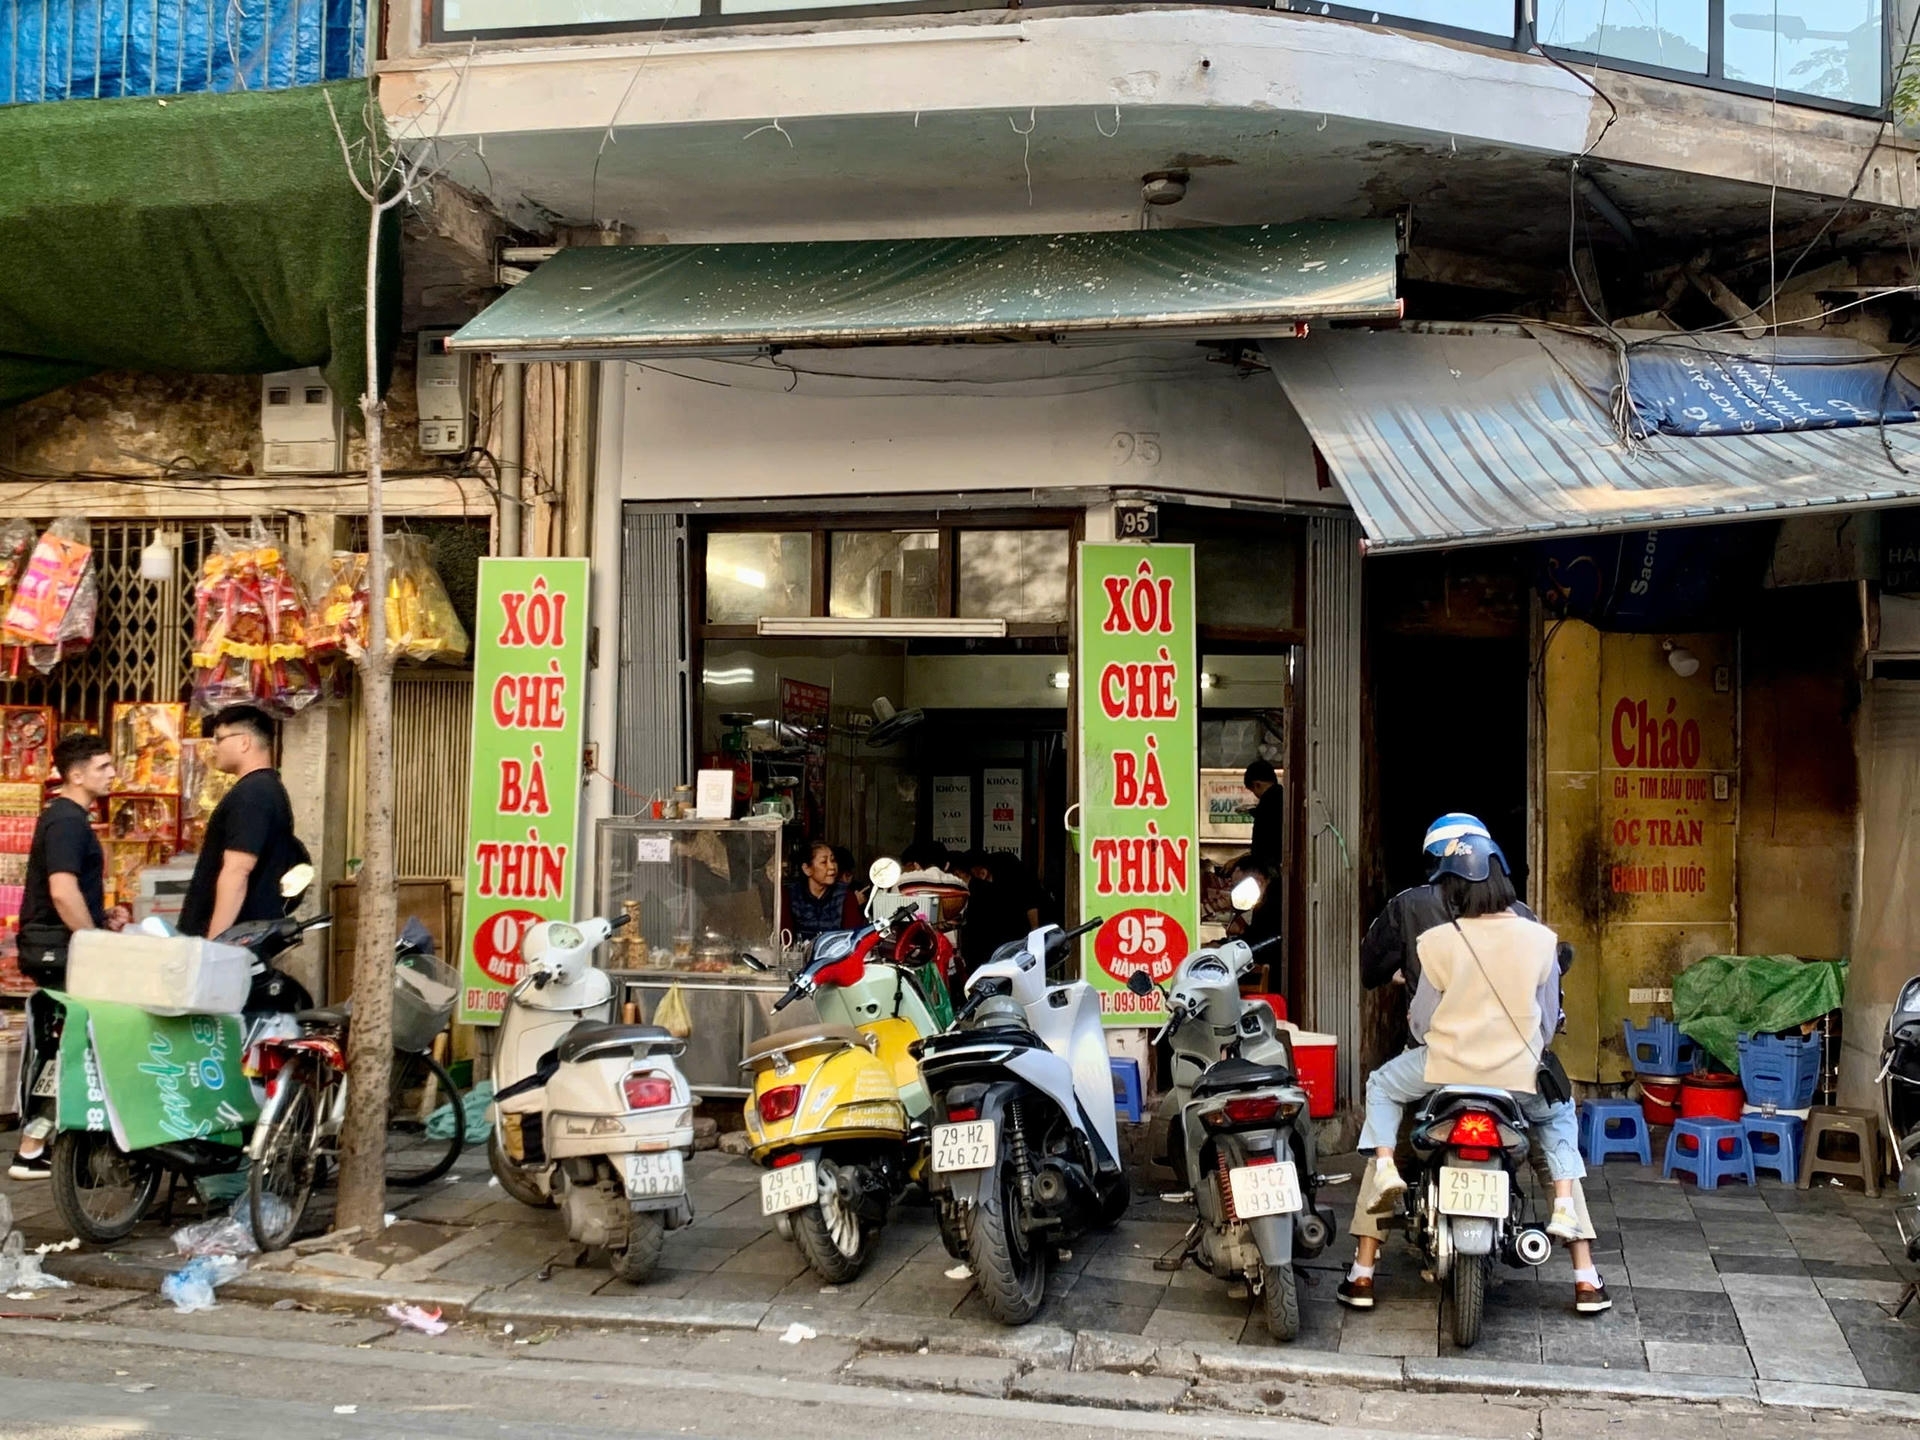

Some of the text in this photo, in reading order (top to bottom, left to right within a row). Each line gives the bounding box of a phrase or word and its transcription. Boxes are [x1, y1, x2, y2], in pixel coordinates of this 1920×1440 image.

[1112, 431, 1162, 467] 95
[1124, 512, 1149, 532] 95
[498, 577, 566, 647] XÔI
[1102, 559, 1173, 633] XÔI
[493, 659, 566, 730] CHÈ
[1100, 647, 1178, 720] CHÈ
[1612, 696, 1700, 769] Cháo
[498, 745, 550, 815] BÀ
[1112, 735, 1168, 807] BÀ
[1639, 776, 1658, 799] TIM
[476, 828, 567, 900] THÌN
[1091, 821, 1189, 894] THÌN
[1117, 915, 1167, 955] 95
[488, 955, 514, 979] BÁT
[467, 989, 485, 1010] ĐT:
[1114, 992, 1136, 1013] 093
[942, 1124, 984, 1147] 29-H2
[937, 1144, 989, 1168] 246.27
[768, 1165, 807, 1192] 29-C1
[1450, 1171, 1498, 1193] 29-T1
[1450, 1191, 1499, 1213] 7075
